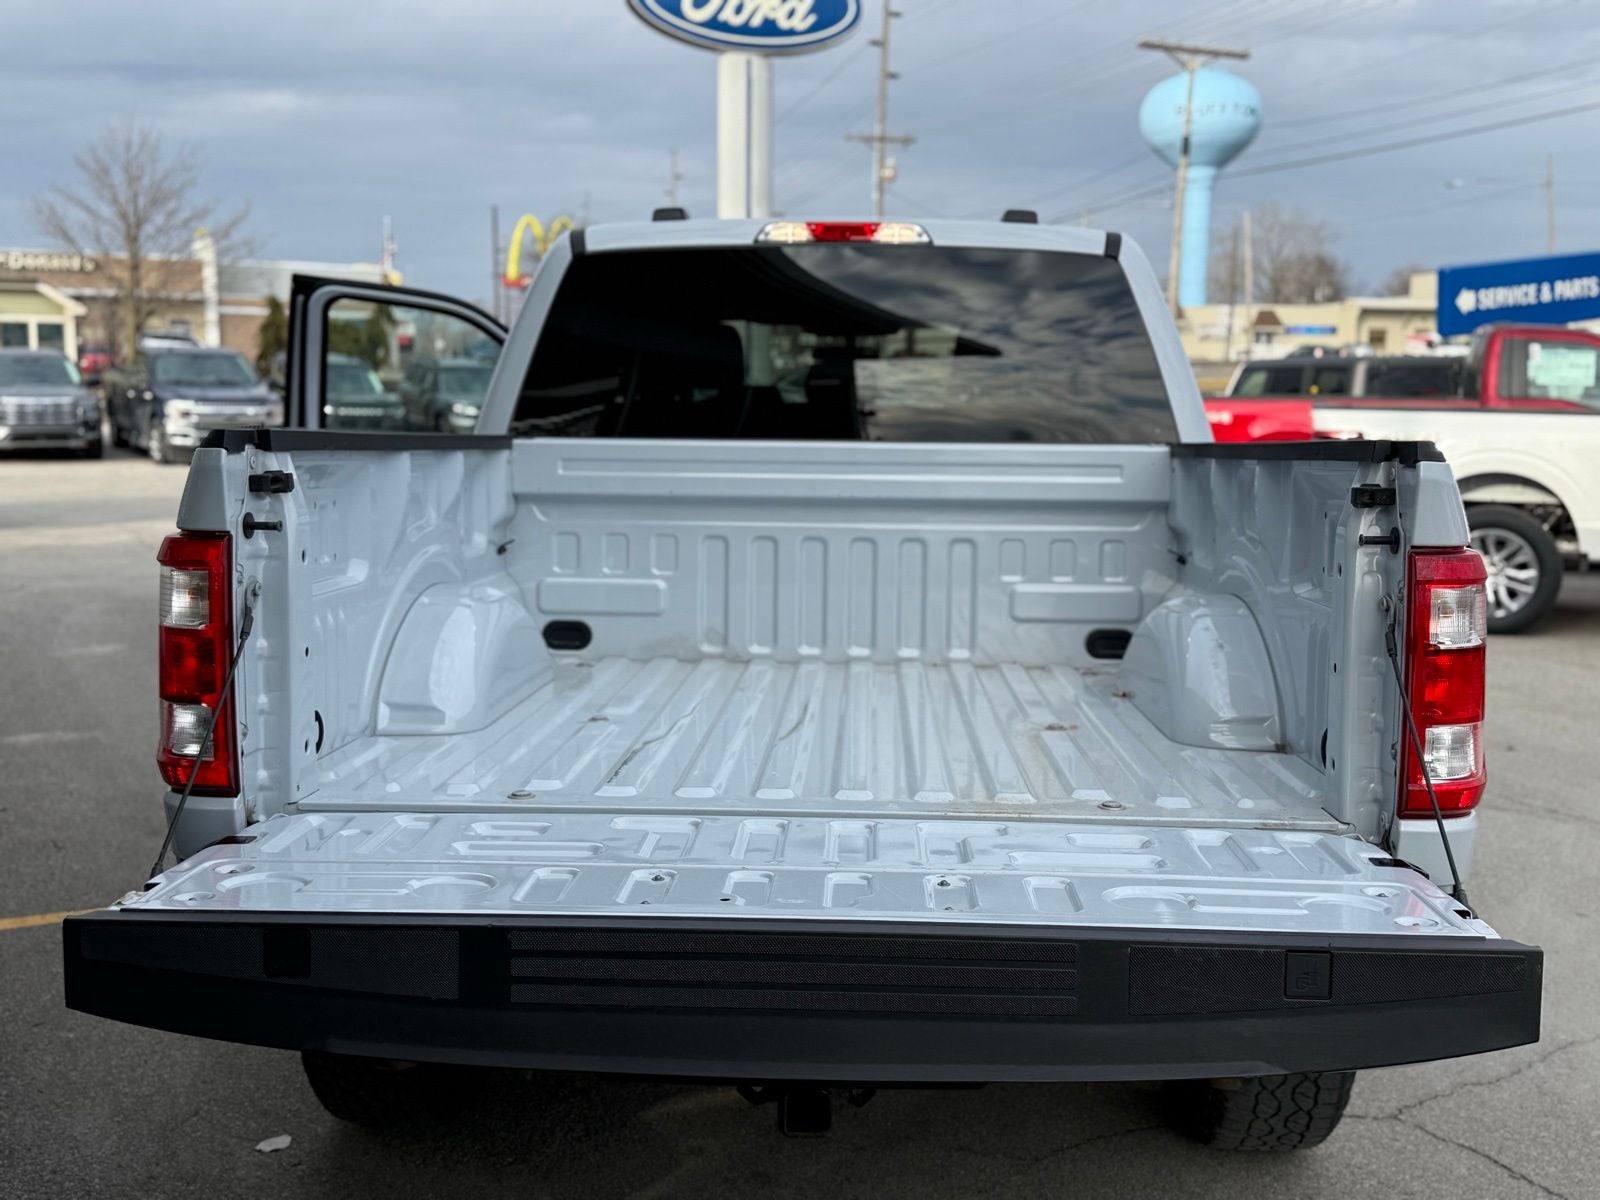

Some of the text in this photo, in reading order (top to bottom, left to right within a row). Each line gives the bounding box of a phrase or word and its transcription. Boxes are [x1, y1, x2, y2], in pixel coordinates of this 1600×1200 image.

[1478, 275, 1599, 311] SERVICE & PARTS
